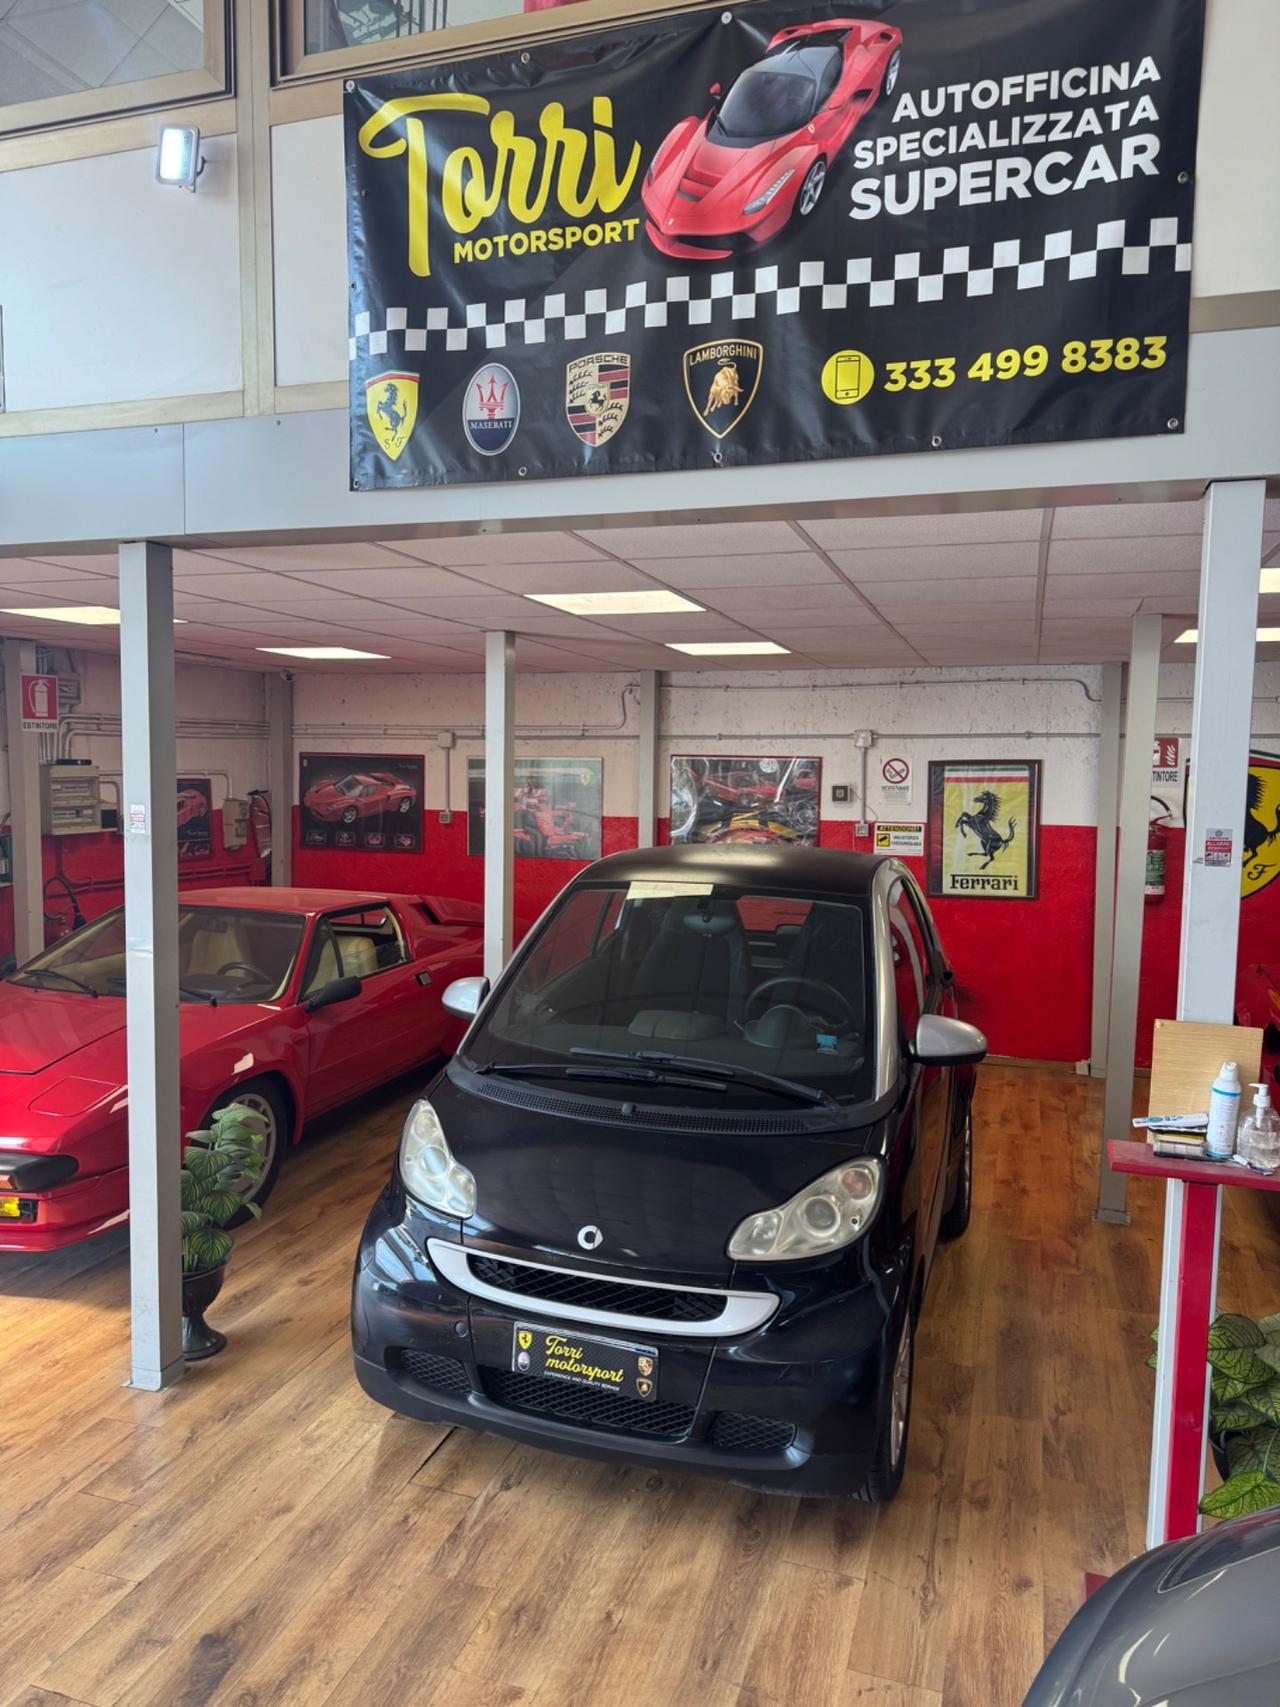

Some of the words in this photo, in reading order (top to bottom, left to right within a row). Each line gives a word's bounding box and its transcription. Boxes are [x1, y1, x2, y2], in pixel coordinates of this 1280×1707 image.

[892, 56, 1161, 123] AUTOFFICINA
[853, 94, 1160, 169] SPECIALIZZATA
[358, 93, 642, 277] Torri
[848, 133, 1161, 220] SUPERCAR
[453, 218, 640, 263] MOTORSPORT
[568, 354, 628, 373] PORSCHE
[689, 344, 757, 366] LAMBORGHINI
[884, 357, 956, 392] 333
[967, 345, 1049, 382] 499
[1061, 336, 1167, 374] 8383
[470, 420, 513, 429] MASERATI
[23, 721, 58, 729] ESTINTORE
[1152, 771, 1178, 782] TINTORE
[949, 874, 1019, 891] Ferrari
[545, 1335, 583, 1359] Torri
[545, 1358, 624, 1382] motorsport
